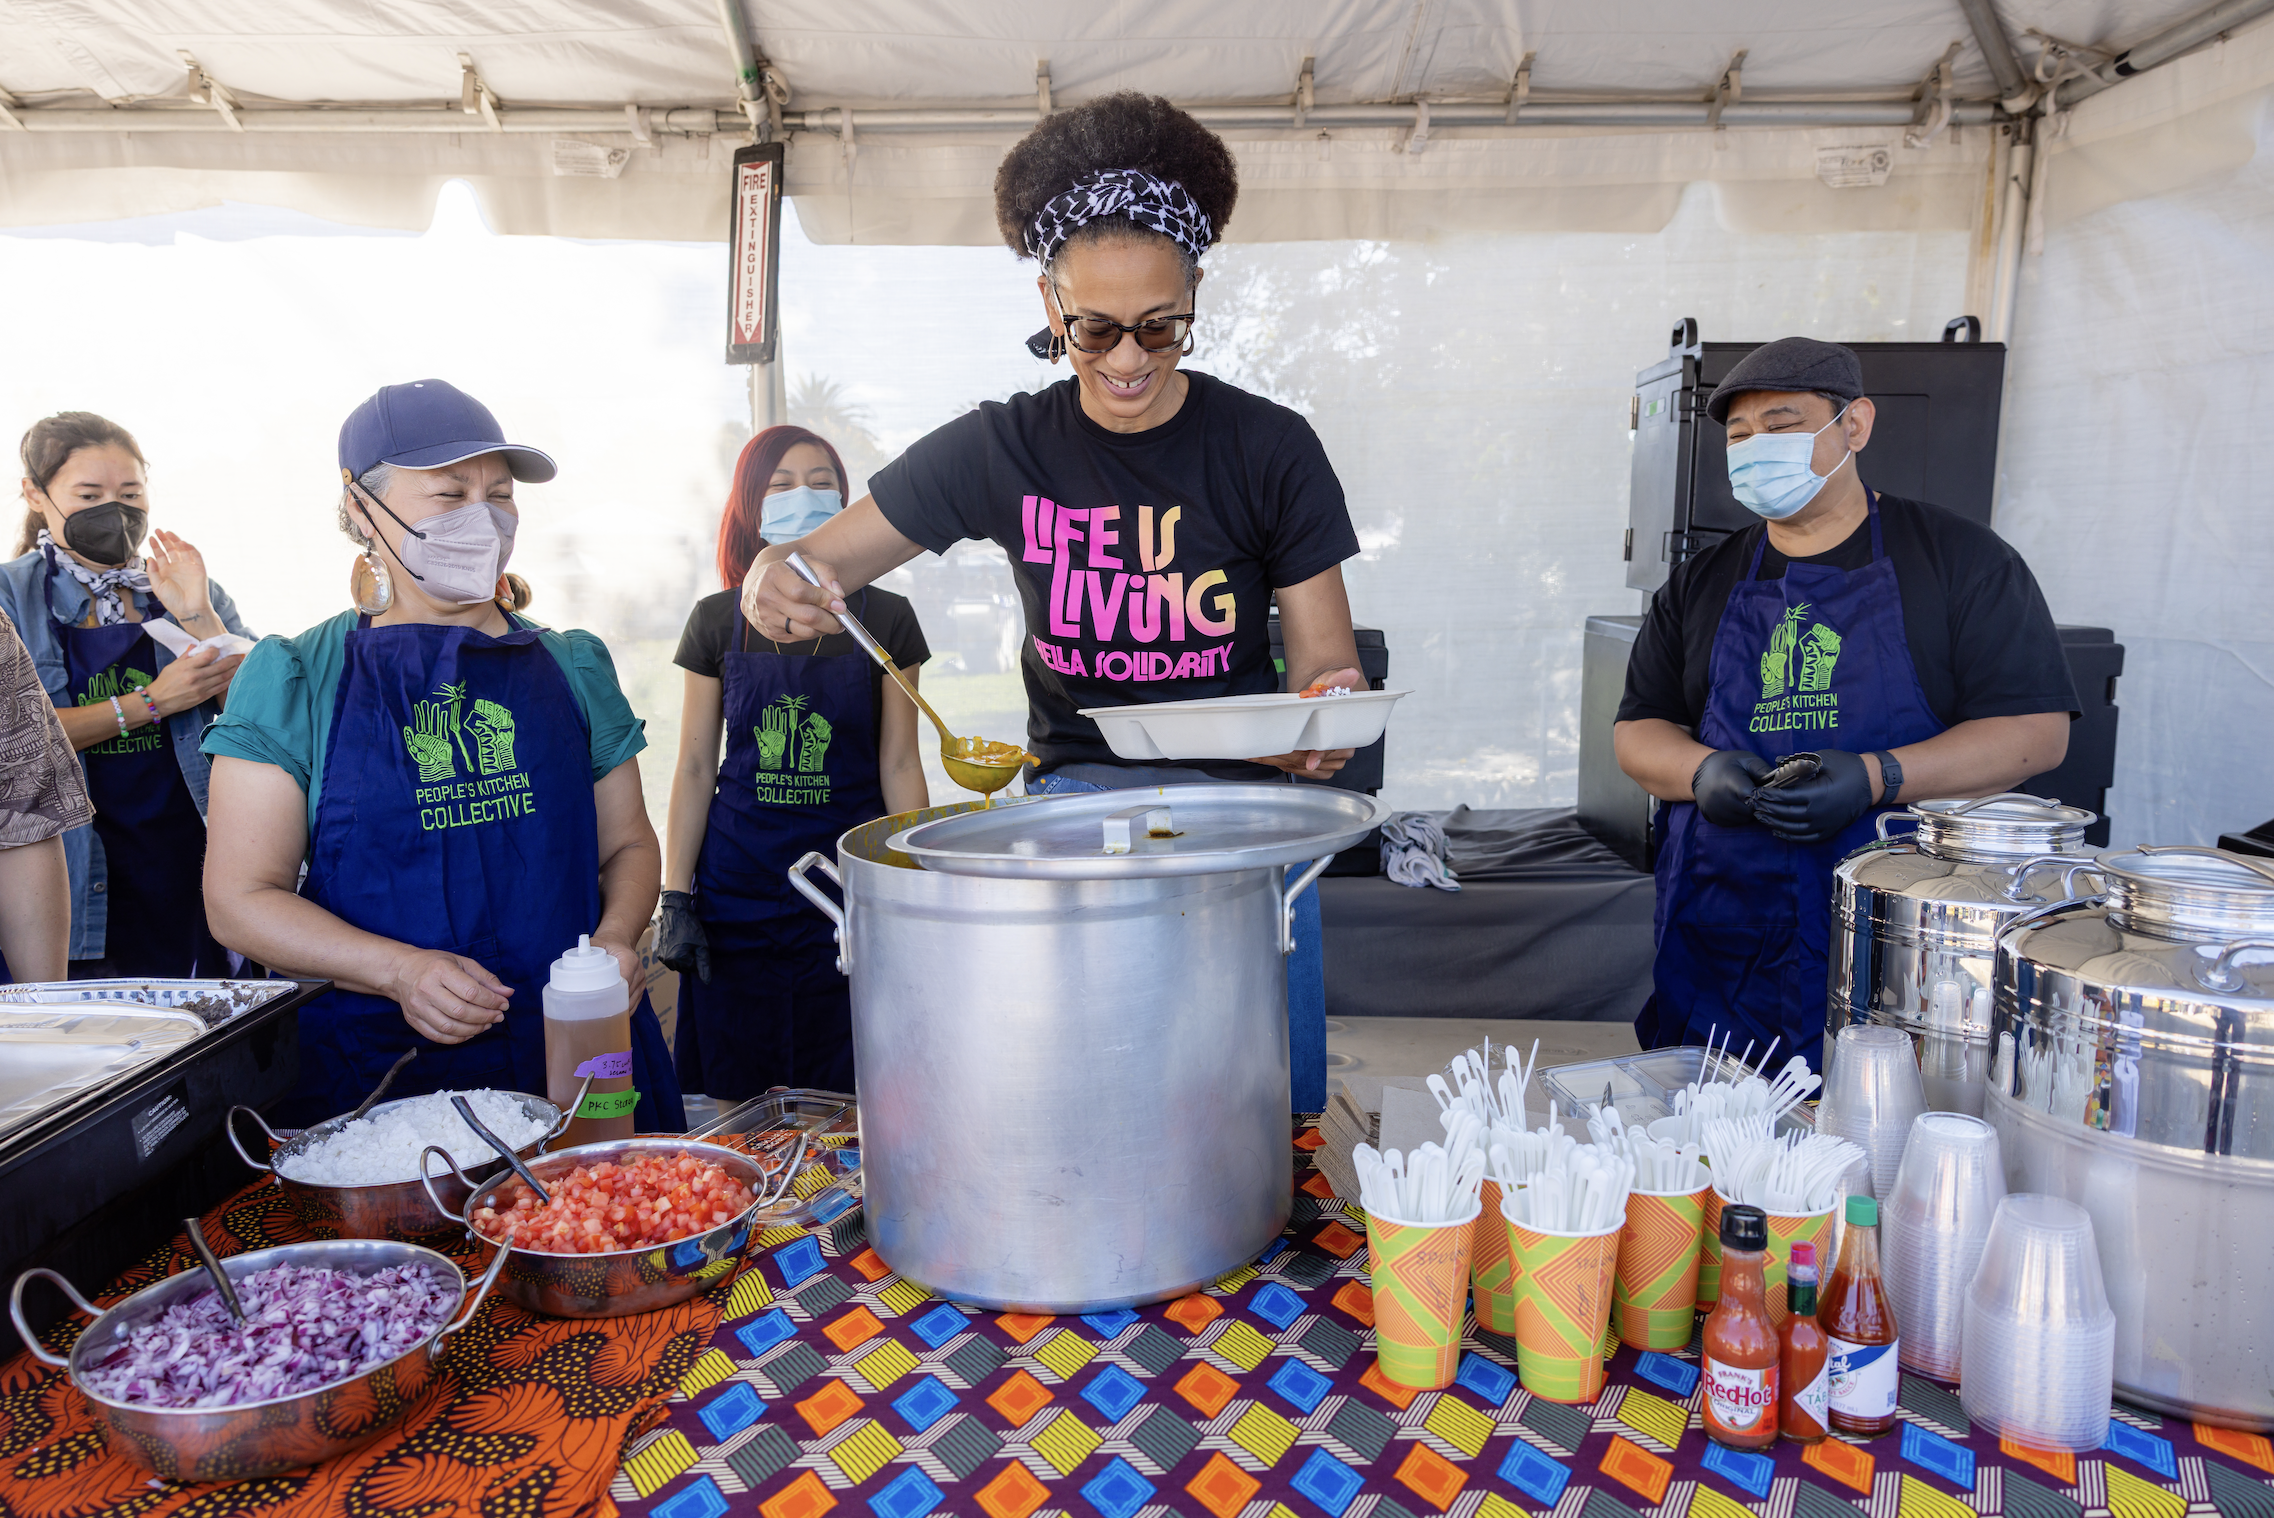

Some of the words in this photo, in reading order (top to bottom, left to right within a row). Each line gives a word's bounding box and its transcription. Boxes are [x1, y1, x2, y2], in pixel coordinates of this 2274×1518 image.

[744, 173, 766, 191] FIRE
[745, 194, 757, 333] EXTINGUISHER
[1021, 494, 1124, 570] LIFE
[1138, 504, 1182, 573] IS
[1032, 634, 1089, 678] HELLA
[1094, 641, 1235, 682] SOLIDARITY
[1754, 696, 1791, 714] PEOPLE'S
[1792, 693, 1838, 708] KITCHEN
[1749, 710, 1839, 733] COLLECTIVE
[416, 782, 476, 805] PEOPLE'S
[476, 772, 530, 797] KITCHEN
[755, 772, 793, 786] PEOPLE'S
[794, 775, 830, 787] KITCHEN
[756, 786, 831, 805] COLLECTIVE
[420, 792, 536, 831] COLLECTIVE
[588, 1100, 609, 1112] PKC
[1718, 1370, 1753, 1385] FRANK'S
[1713, 1398, 1756, 1415] ORIGINAL
